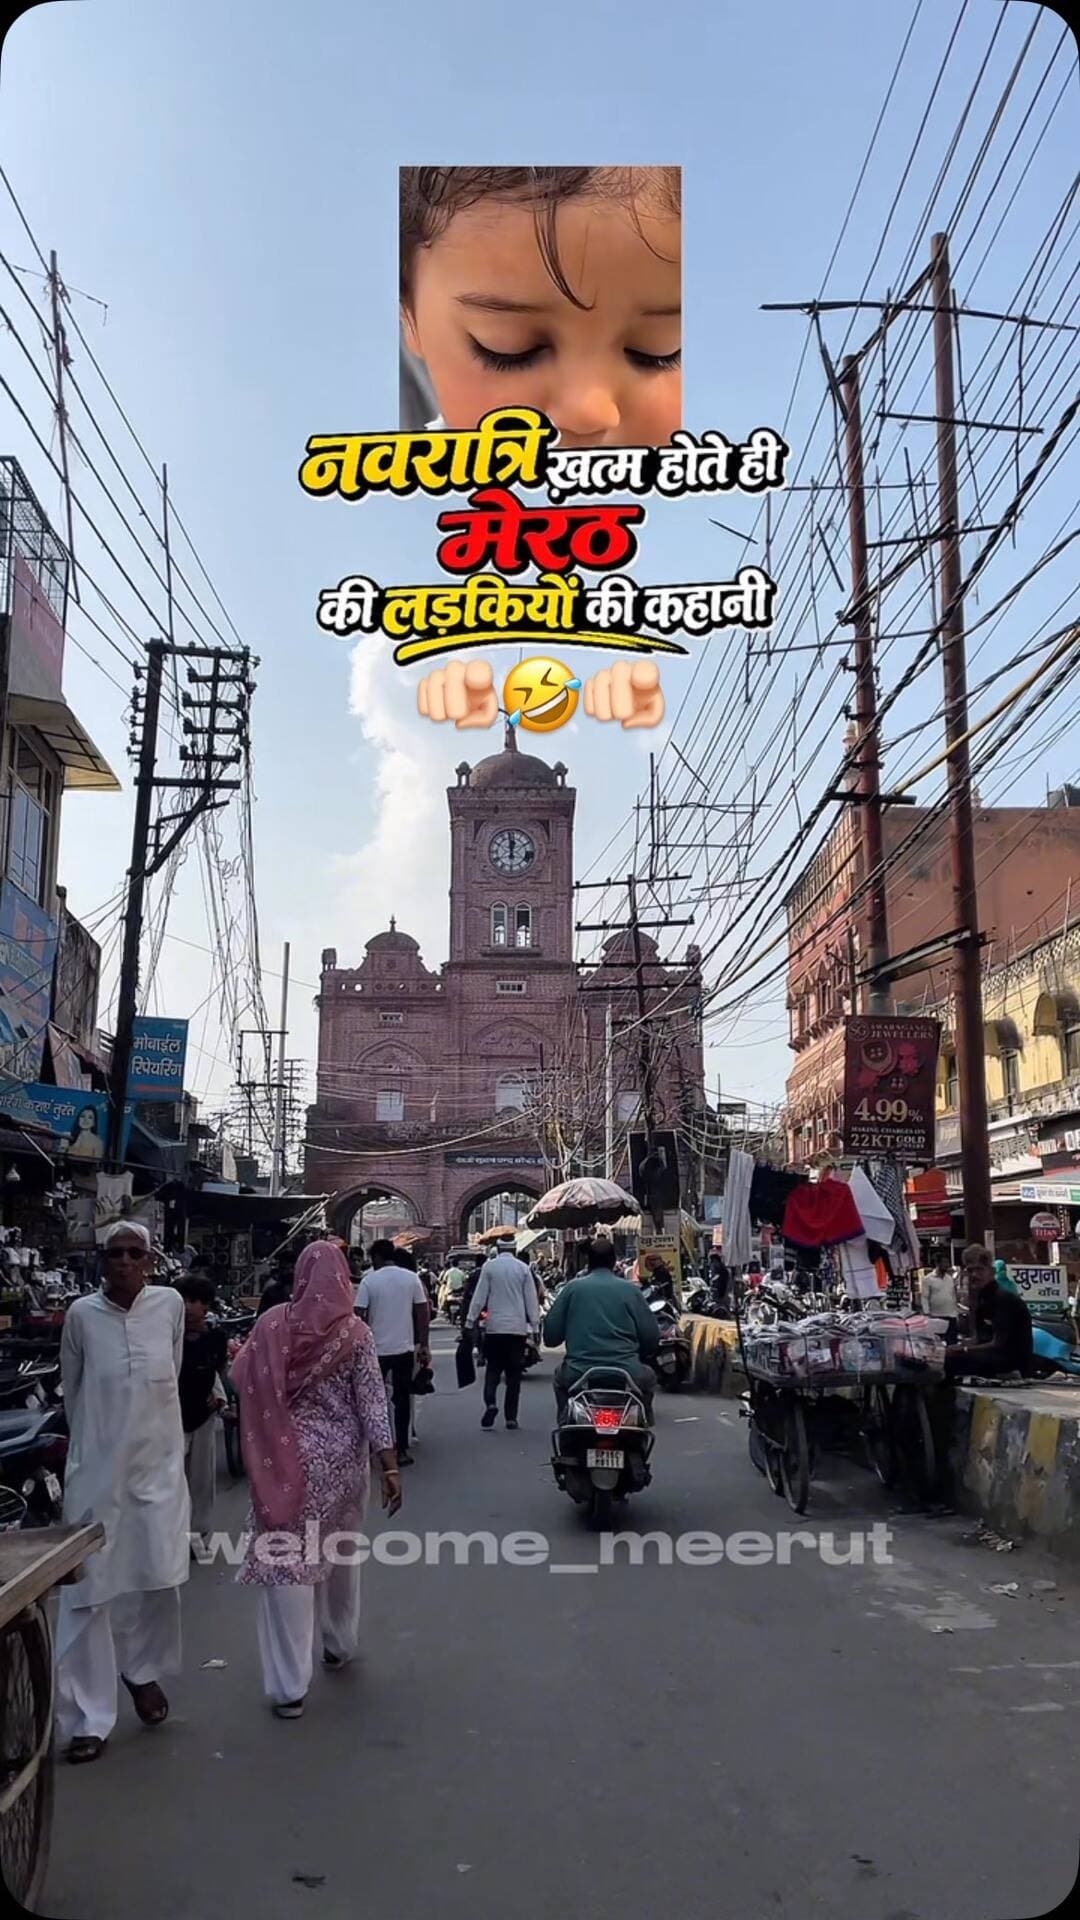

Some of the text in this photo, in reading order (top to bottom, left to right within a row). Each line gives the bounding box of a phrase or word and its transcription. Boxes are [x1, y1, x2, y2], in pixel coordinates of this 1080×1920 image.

[870, 1030, 934, 1040] JEWELLERS
[854, 1097, 924, 1123] 4.99%
[851, 1133, 896, 1148] 22KT
[896, 1135, 926, 1144] GOLD
[1012, 1268, 1061, 1290] खुराना
